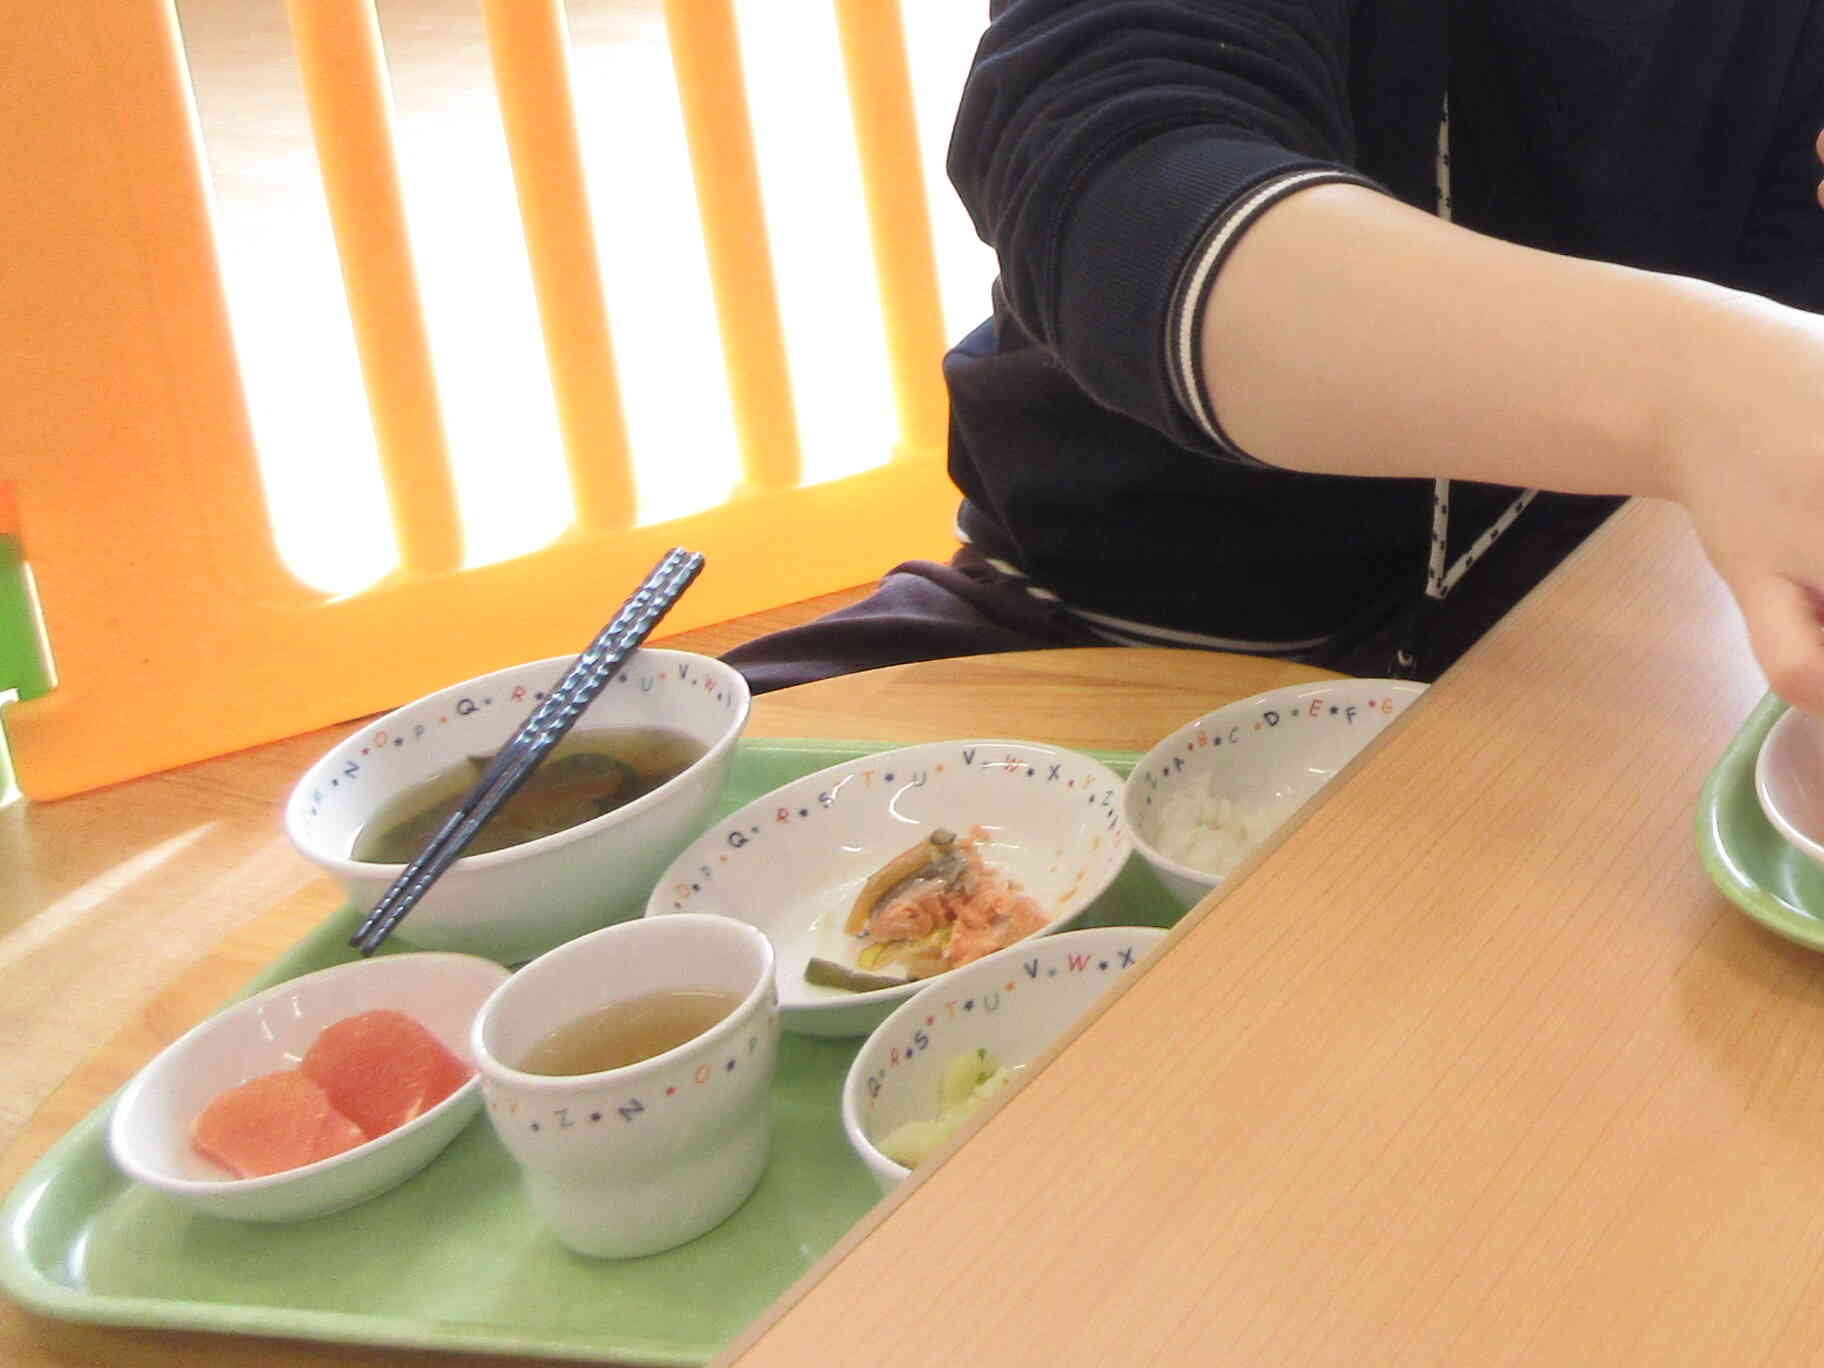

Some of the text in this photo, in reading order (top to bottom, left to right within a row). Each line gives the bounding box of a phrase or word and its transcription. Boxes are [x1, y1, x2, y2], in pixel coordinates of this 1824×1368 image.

[456, 698, 478, 715] Q
[679, 664, 688, 679] V
[1264, 711, 1280, 727] D
[1310, 699, 1323, 717] E
[1346, 706, 1357, 723] F
[728, 831, 749, 848] Q
[963, 749, 975, 765] V
[1048, 764, 1061, 781] X
[915, 1031, 928, 1050] S
[984, 993, 999, 1011] U
[1024, 959, 1038, 979] V
[1067, 953, 1091, 972] W
[1118, 946, 1135, 968] X
